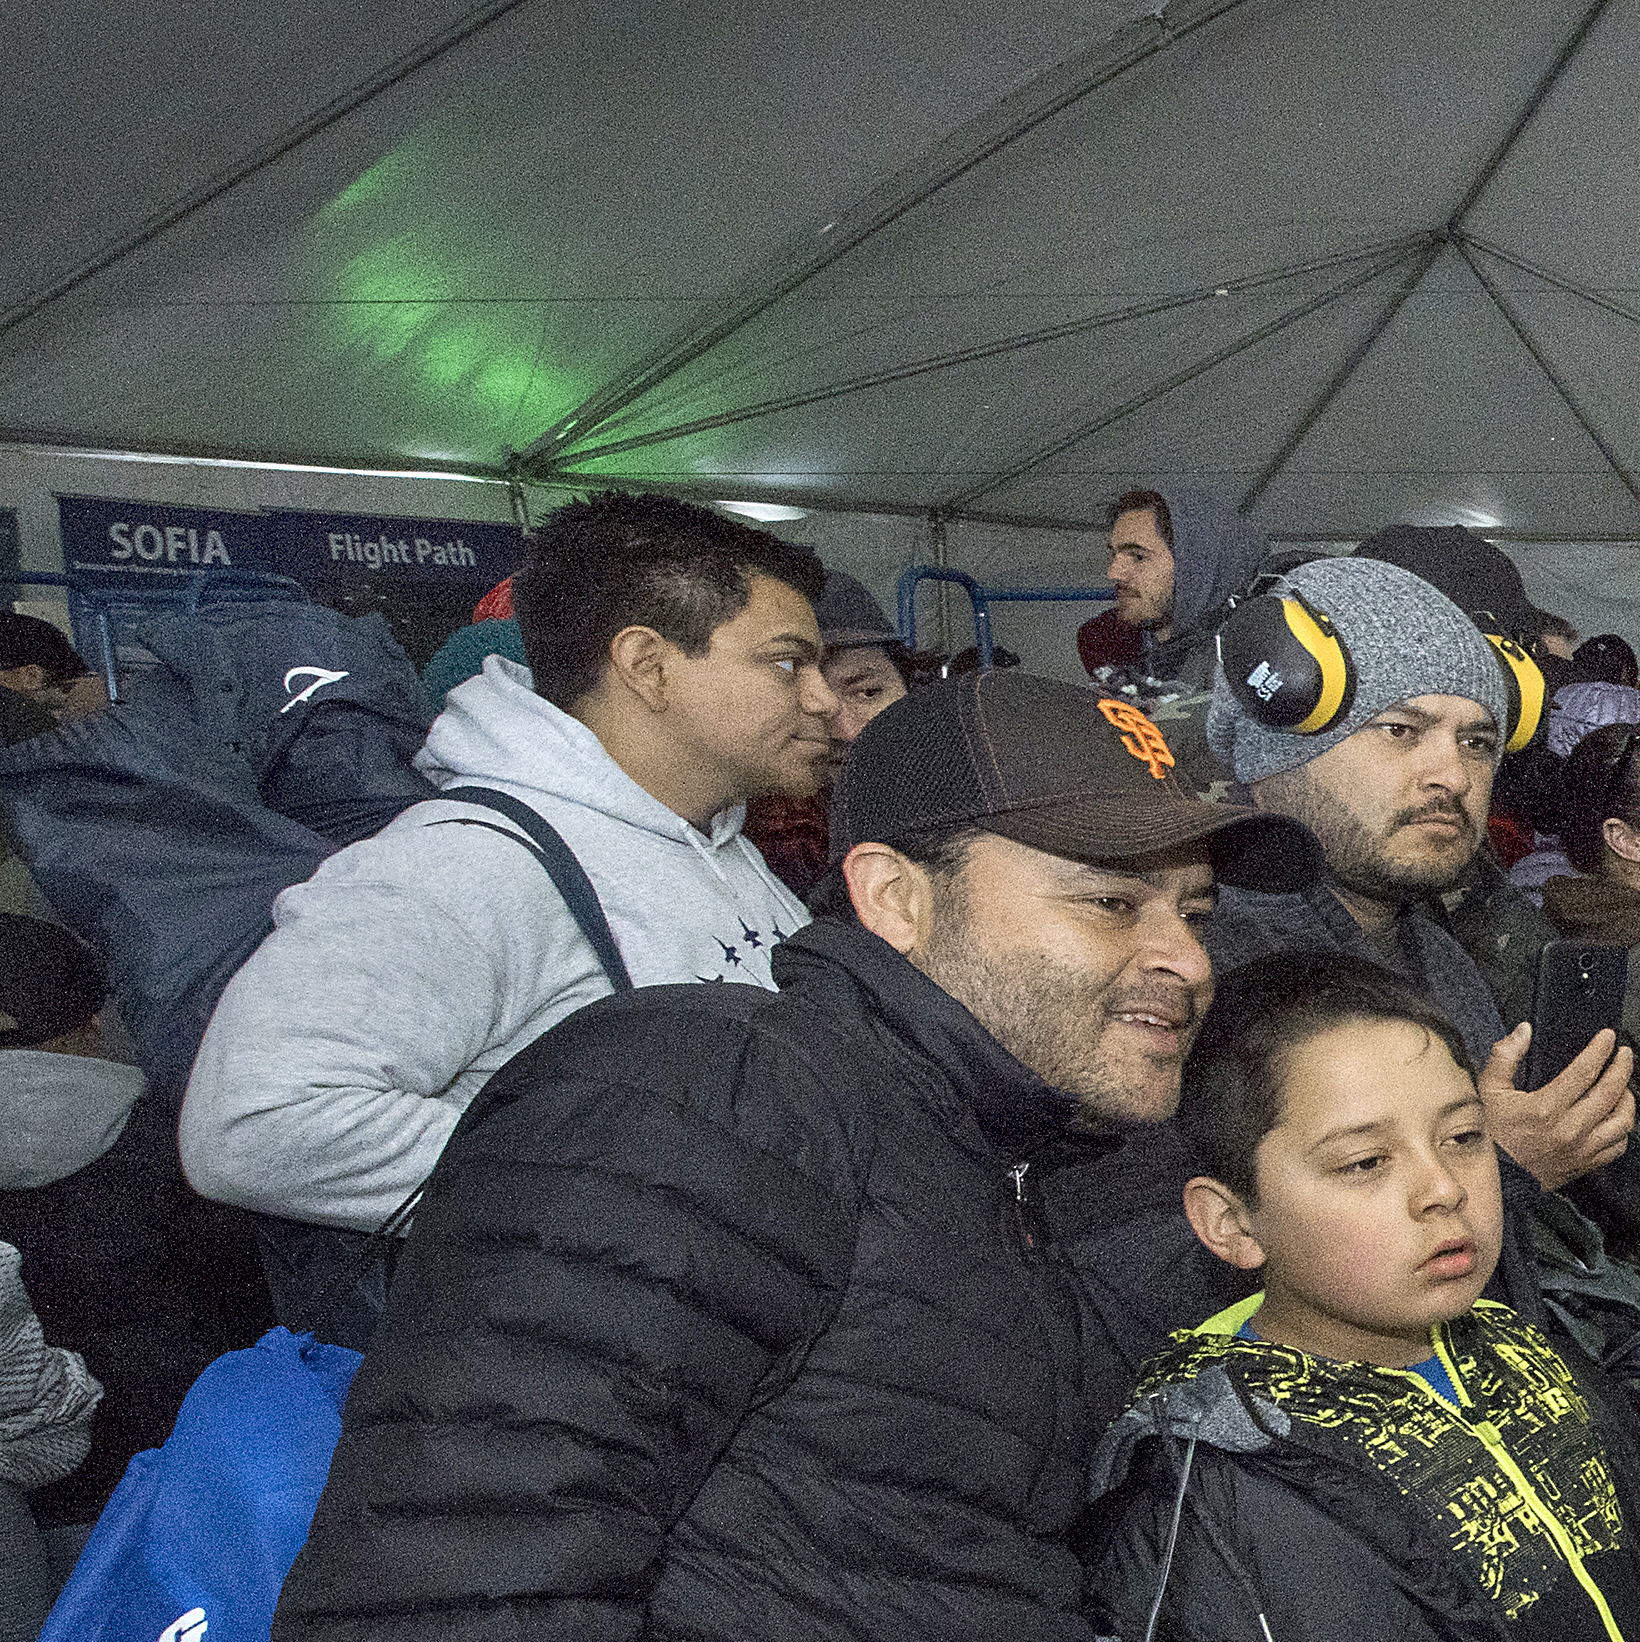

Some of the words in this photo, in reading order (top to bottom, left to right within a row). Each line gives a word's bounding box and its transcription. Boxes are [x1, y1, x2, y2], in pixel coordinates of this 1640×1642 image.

[109, 522, 230, 565] SOFIA
[329, 533, 408, 570] Flight
[416, 539, 476, 568] Path
